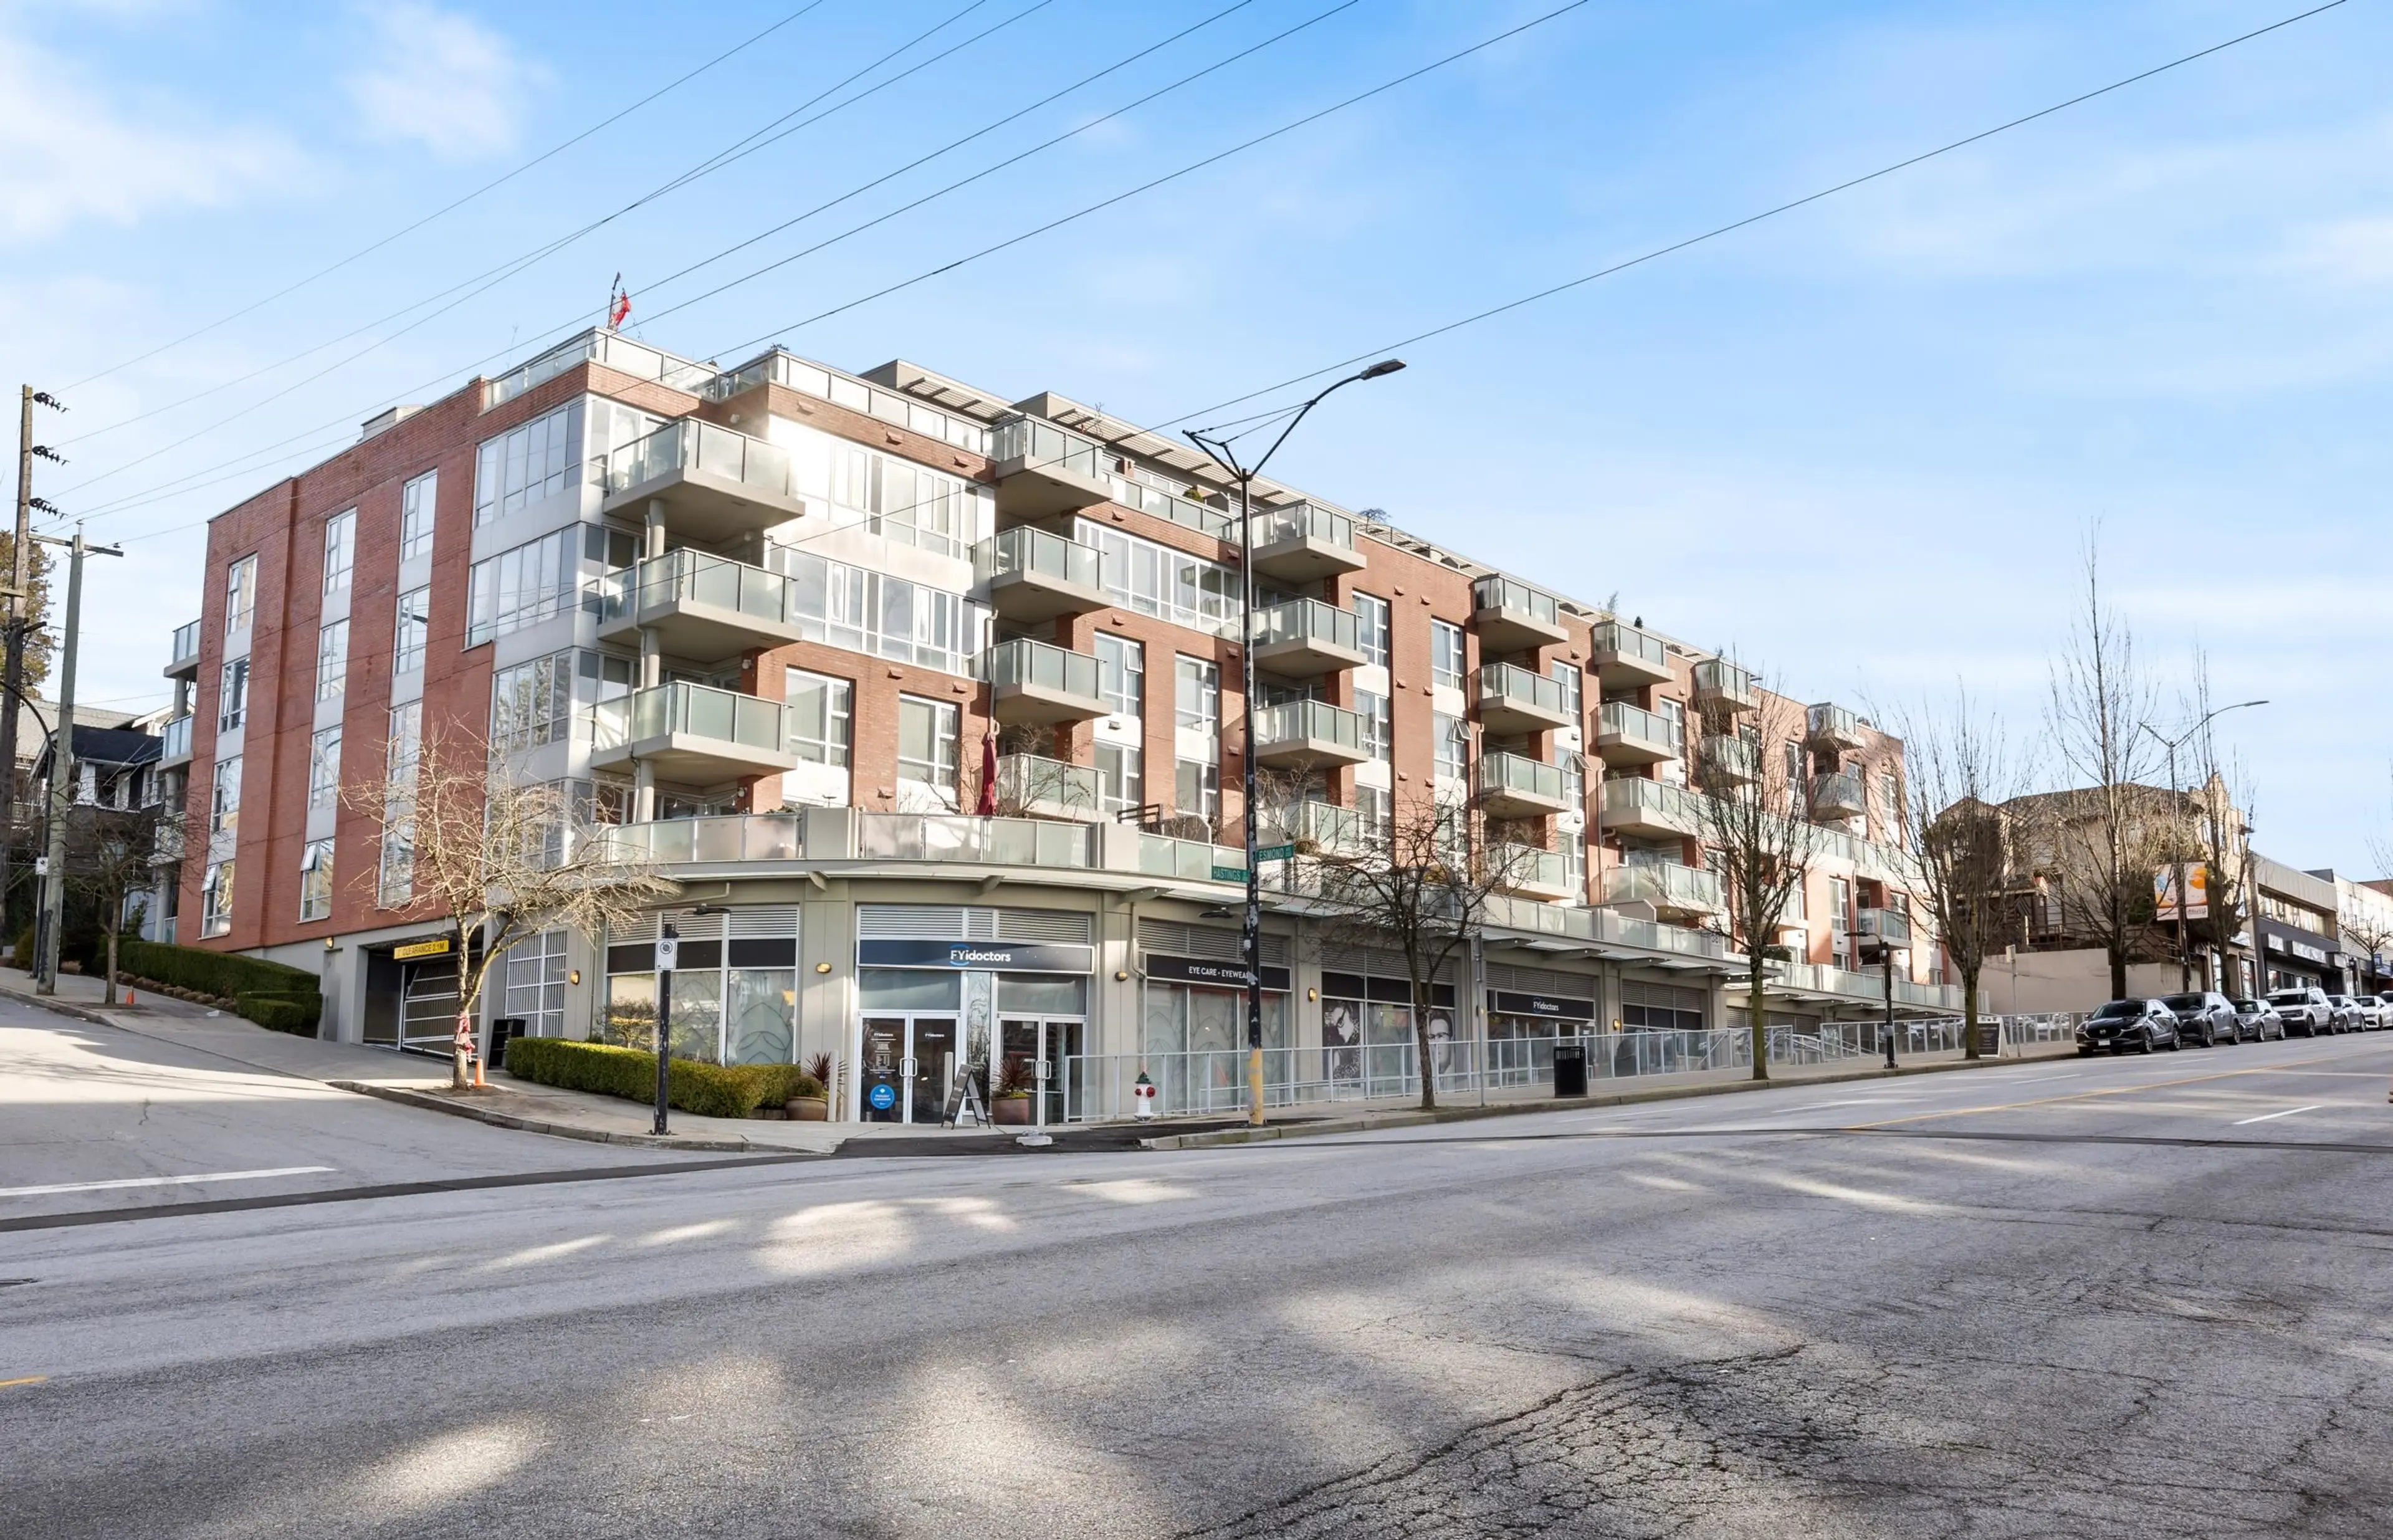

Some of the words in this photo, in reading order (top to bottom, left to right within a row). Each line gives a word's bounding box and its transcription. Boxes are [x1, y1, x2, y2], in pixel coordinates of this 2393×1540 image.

[1259, 848, 1284, 860] ESMOND
[1213, 868, 1241, 881] HASTINGS
[403, 944, 432, 956] CLEARANCE
[950, 950, 1011, 962] FYidoctors
[1188, 966, 1200, 975] EYE
[1201, 967, 1217, 976] CARE
[1221, 970, 1248, 979] EYEWEA
